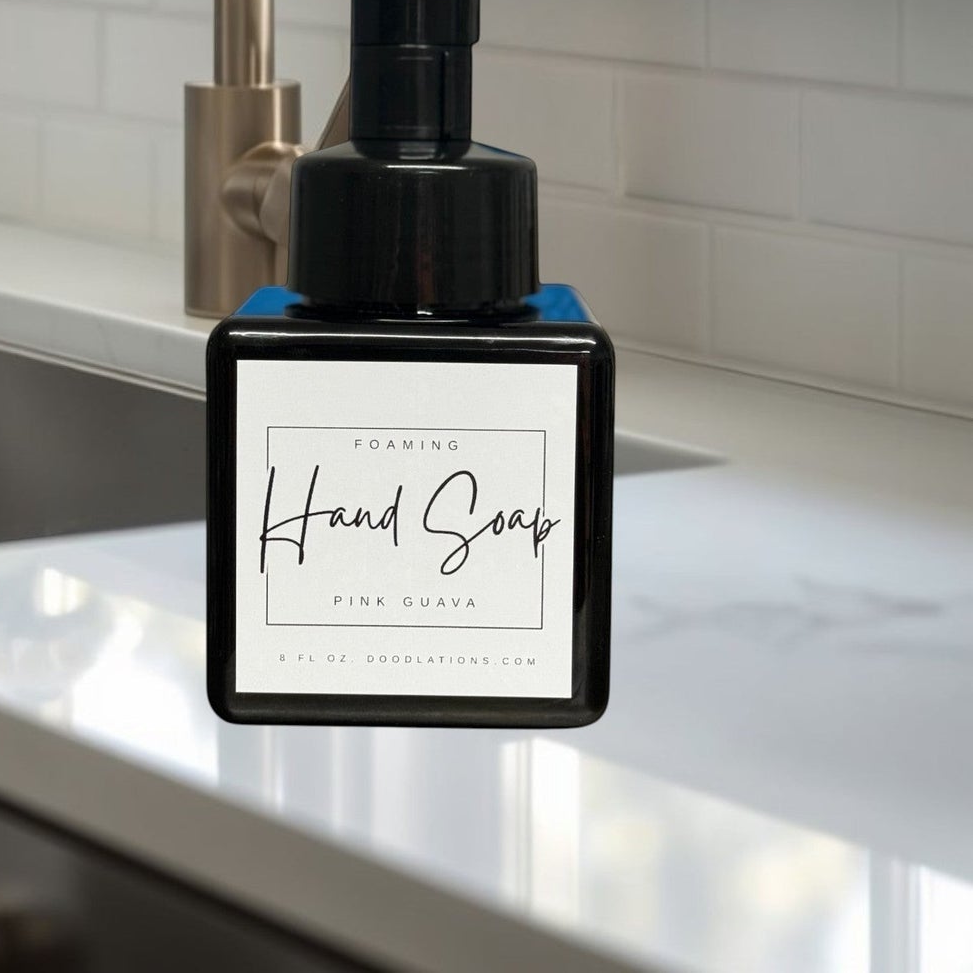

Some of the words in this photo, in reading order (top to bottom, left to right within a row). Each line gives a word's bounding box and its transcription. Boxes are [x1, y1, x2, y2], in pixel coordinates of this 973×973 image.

[353, 437, 459, 452] FOAMING
[259, 464, 403, 574] Hand
[423, 470, 561, 576] Soap
[332, 594, 386, 608] PINK
[401, 595, 477, 609] GUAVA
[278, 653, 287, 663] 8
[297, 653, 314, 663] FL
[326, 653, 355, 664] OZ.
[366, 654, 537, 667] DOODLATIONS.COM
